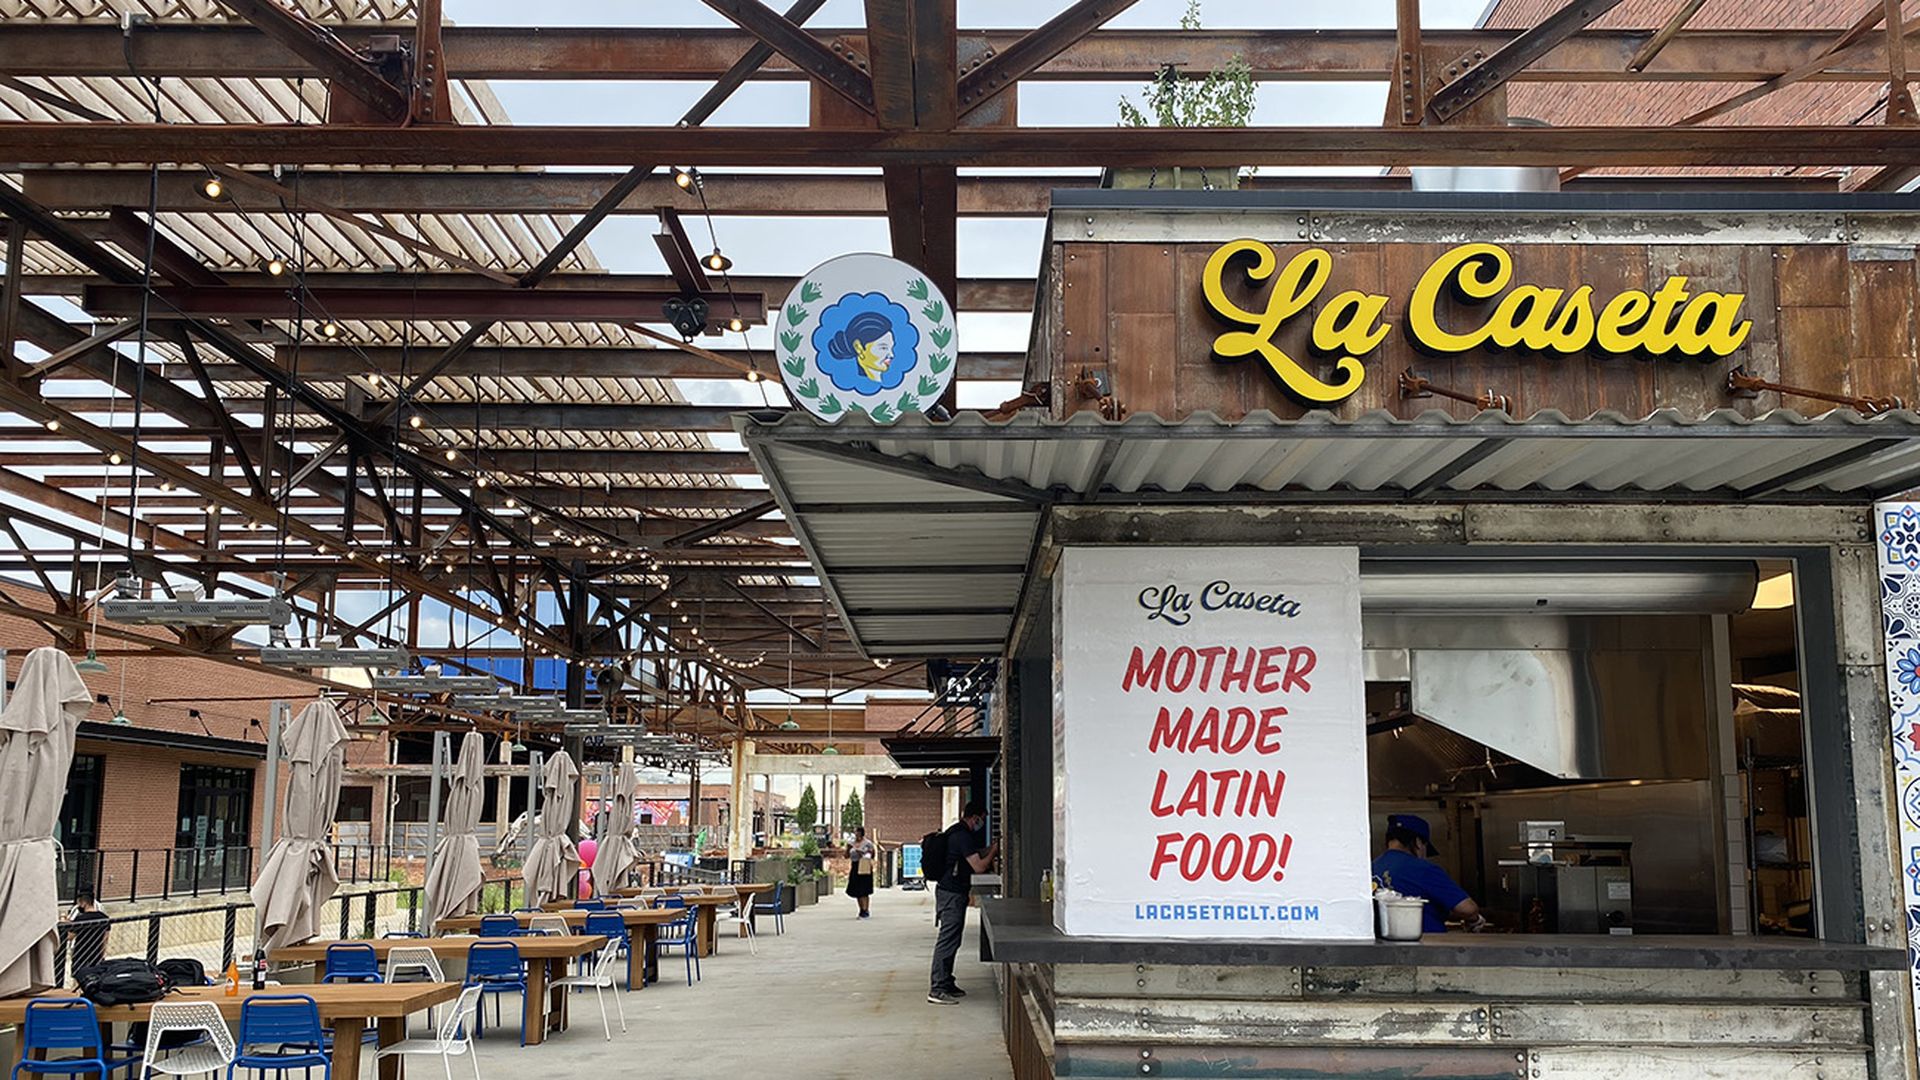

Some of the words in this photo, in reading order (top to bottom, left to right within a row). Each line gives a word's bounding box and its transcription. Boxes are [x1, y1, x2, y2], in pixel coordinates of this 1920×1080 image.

[1202, 239, 1392, 402] La
[1406, 243, 1753, 357] Caseta
[1138, 583, 1193, 626] La
[1201, 580, 1302, 619] Caseta
[1121, 646, 1317, 694] MOTHER
[1148, 706, 1288, 755] MADE
[1150, 769, 1286, 818] LATIN
[1149, 832, 1293, 883] FOOD!
[1135, 904, 1320, 921] LACASETACLT.COM
